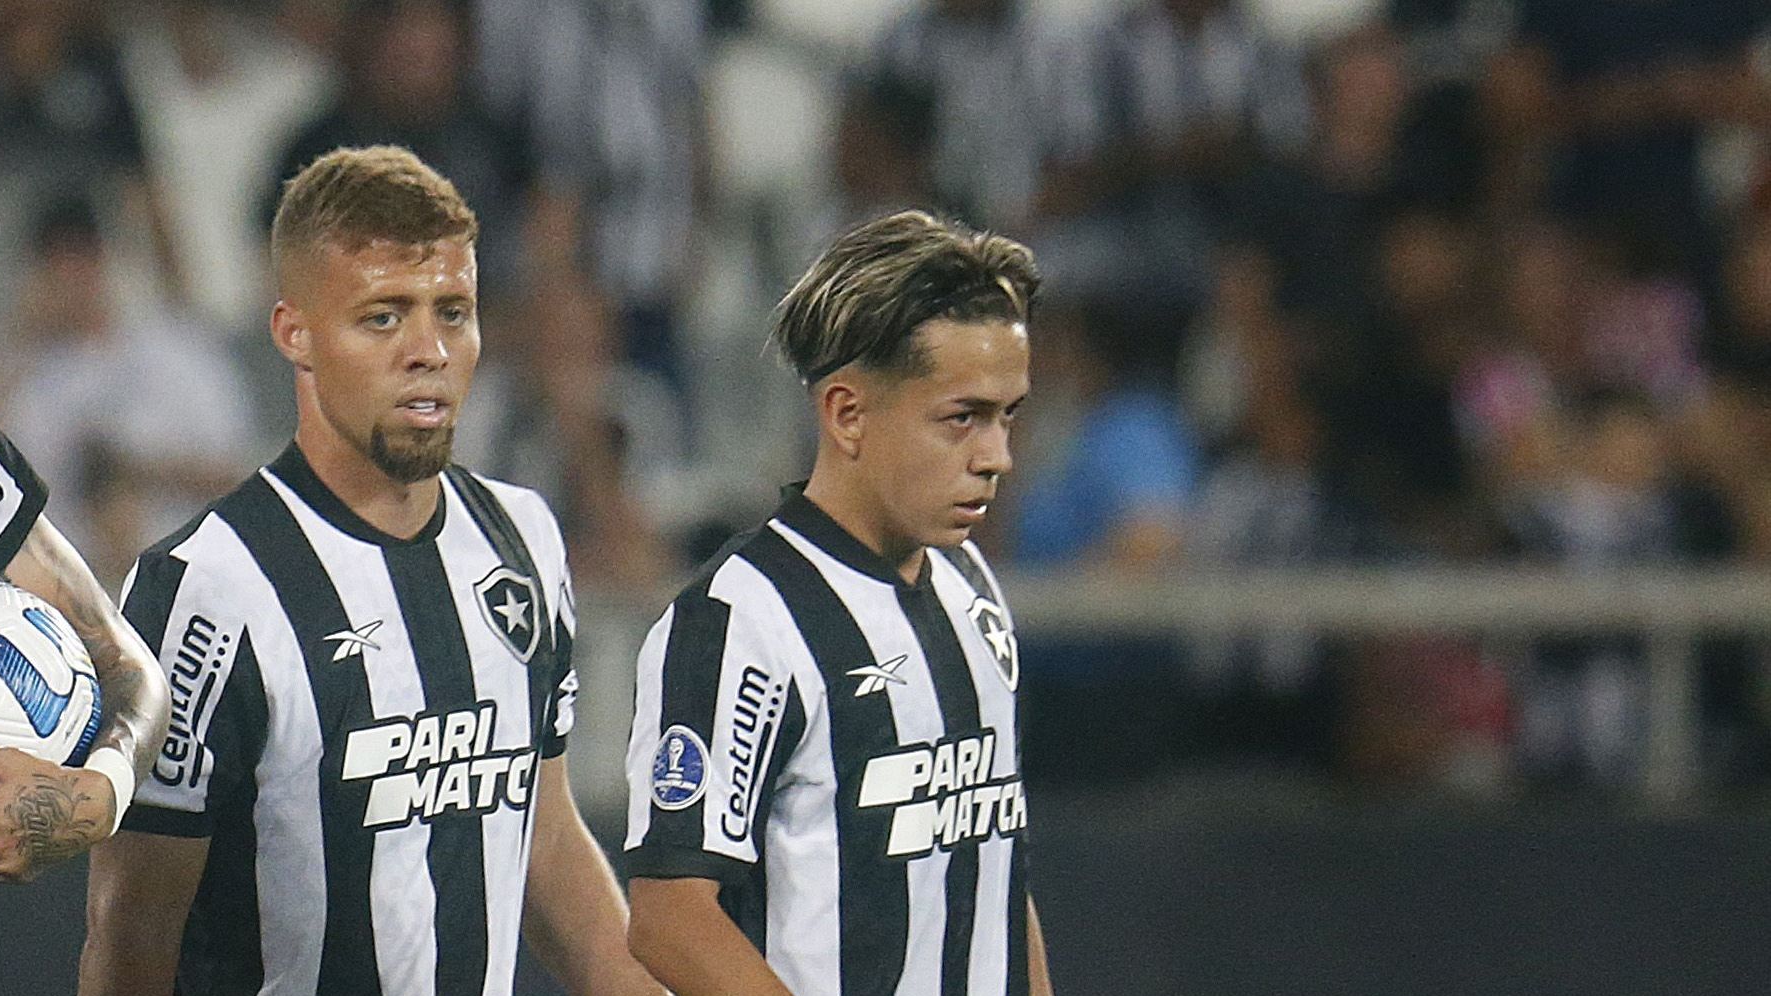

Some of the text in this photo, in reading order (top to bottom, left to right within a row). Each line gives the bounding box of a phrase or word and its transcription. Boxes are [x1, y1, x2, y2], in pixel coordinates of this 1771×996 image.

[342, 706, 494, 781] PARI
[721, 665, 771, 843] Centrum
[858, 734, 995, 808] PARI
[362, 751, 537, 827] MATC
